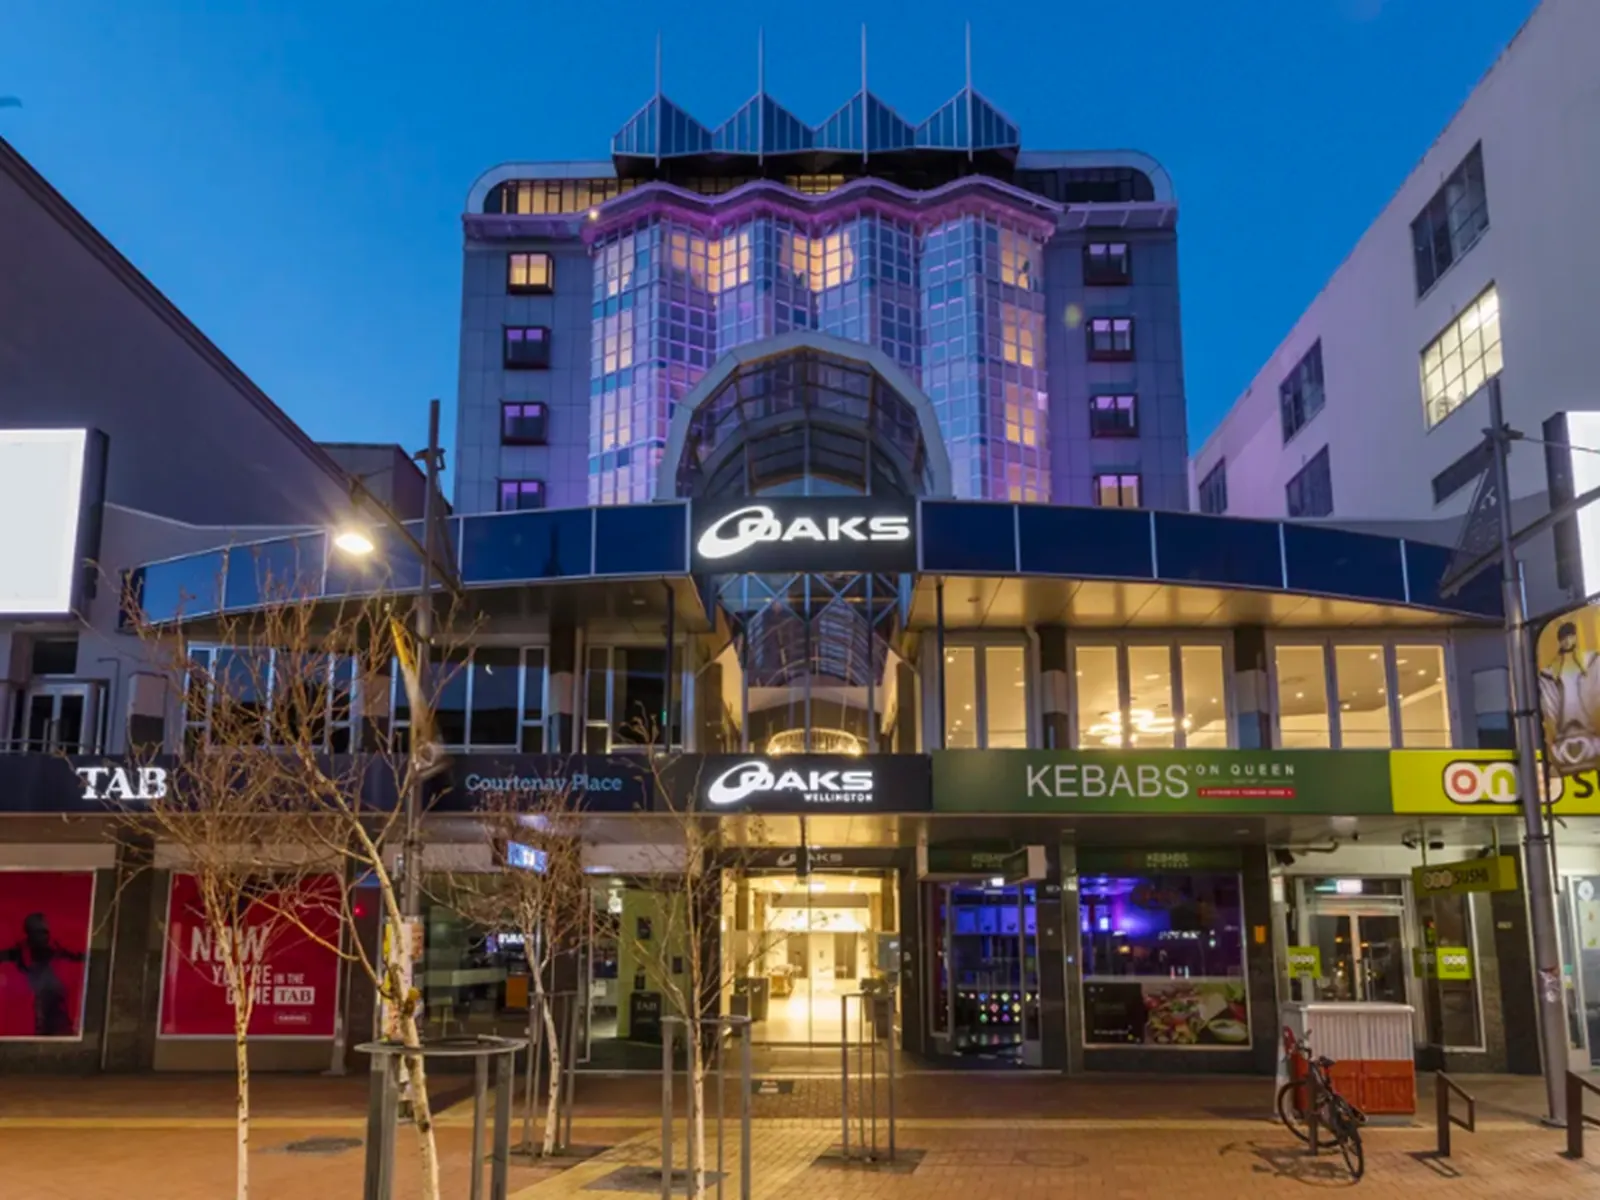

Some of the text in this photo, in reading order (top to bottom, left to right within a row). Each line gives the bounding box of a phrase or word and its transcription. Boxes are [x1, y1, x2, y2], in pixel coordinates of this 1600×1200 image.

[697, 505, 911, 559] OAKS
[76, 767, 167, 799] TAB
[465, 774, 623, 793] Courtenay Place
[708, 760, 874, 804] OAKS
[1026, 764, 1190, 798] KEBABS
[1196, 764, 1219, 776] ON
[1231, 764, 1295, 776] QUEEN
[803, 792, 874, 803] WELLINGTON
[278, 990, 312, 1002] TAB
